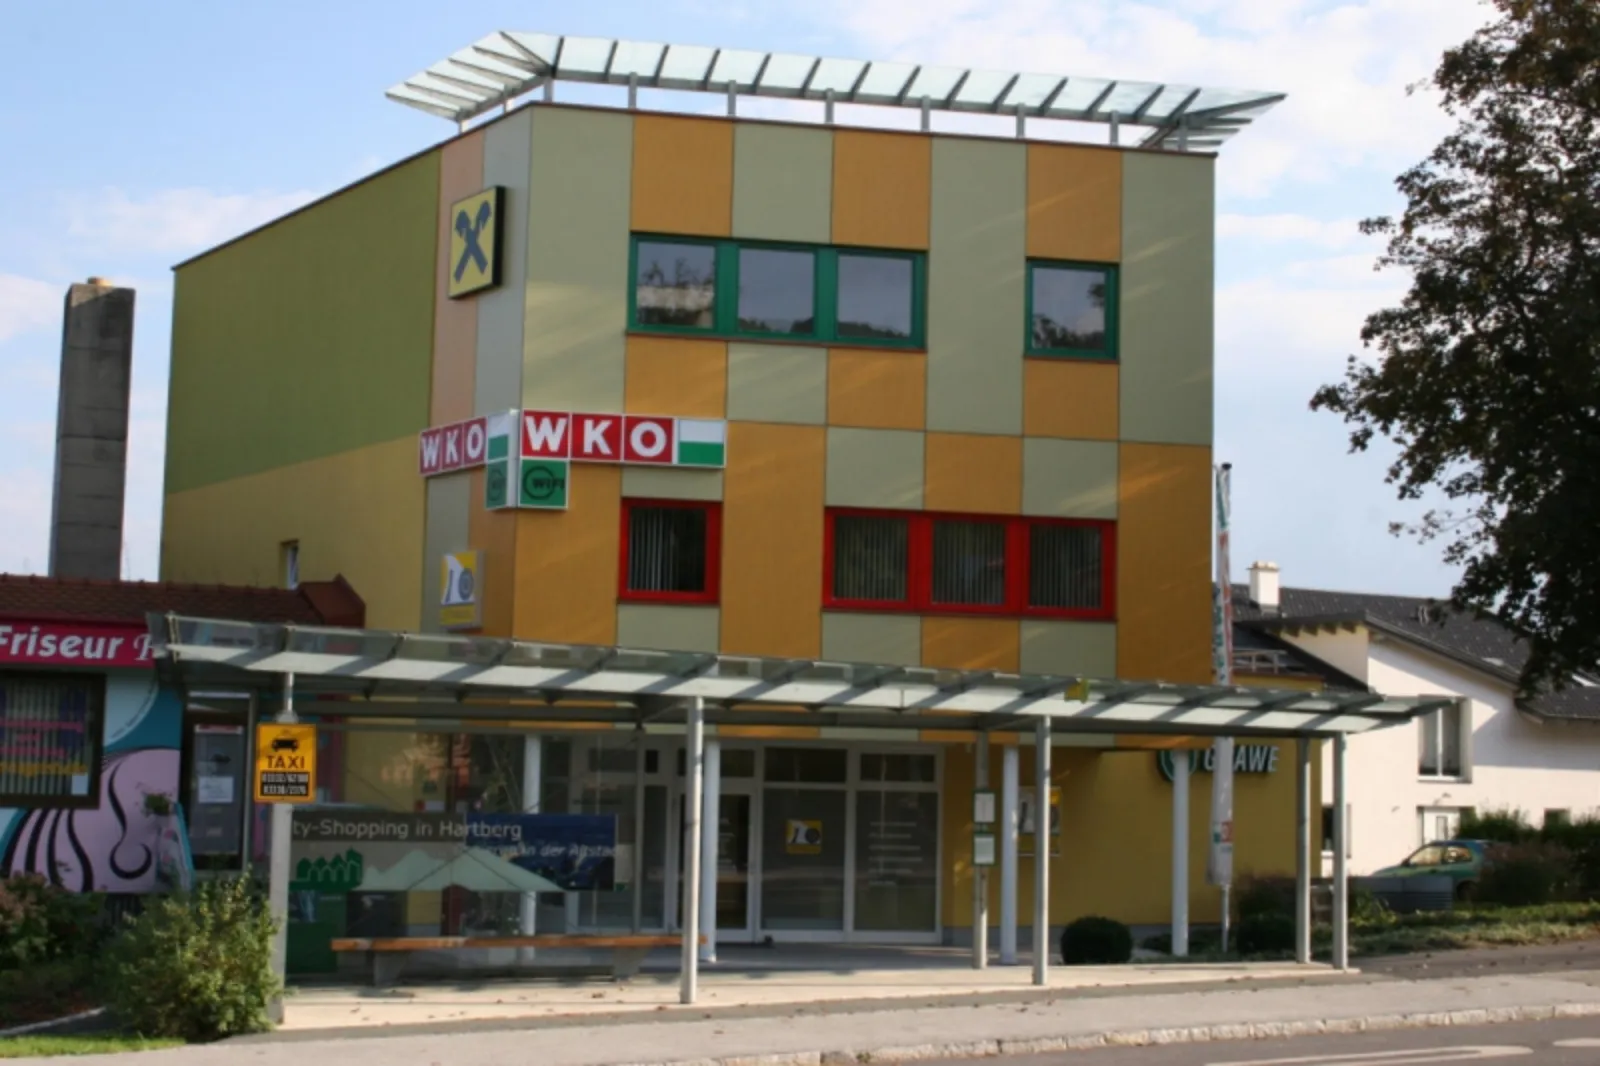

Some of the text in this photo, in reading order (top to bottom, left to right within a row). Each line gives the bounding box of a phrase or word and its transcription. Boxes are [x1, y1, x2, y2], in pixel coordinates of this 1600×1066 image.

[421, 423, 484, 469] WKO
[524, 415, 667, 458] WKO
[266, 755, 305, 769] TAXI
[1204, 744, 1279, 772] GAWE
[415, 819, 433, 836] in
[439, 820, 522, 841] Hartberg
